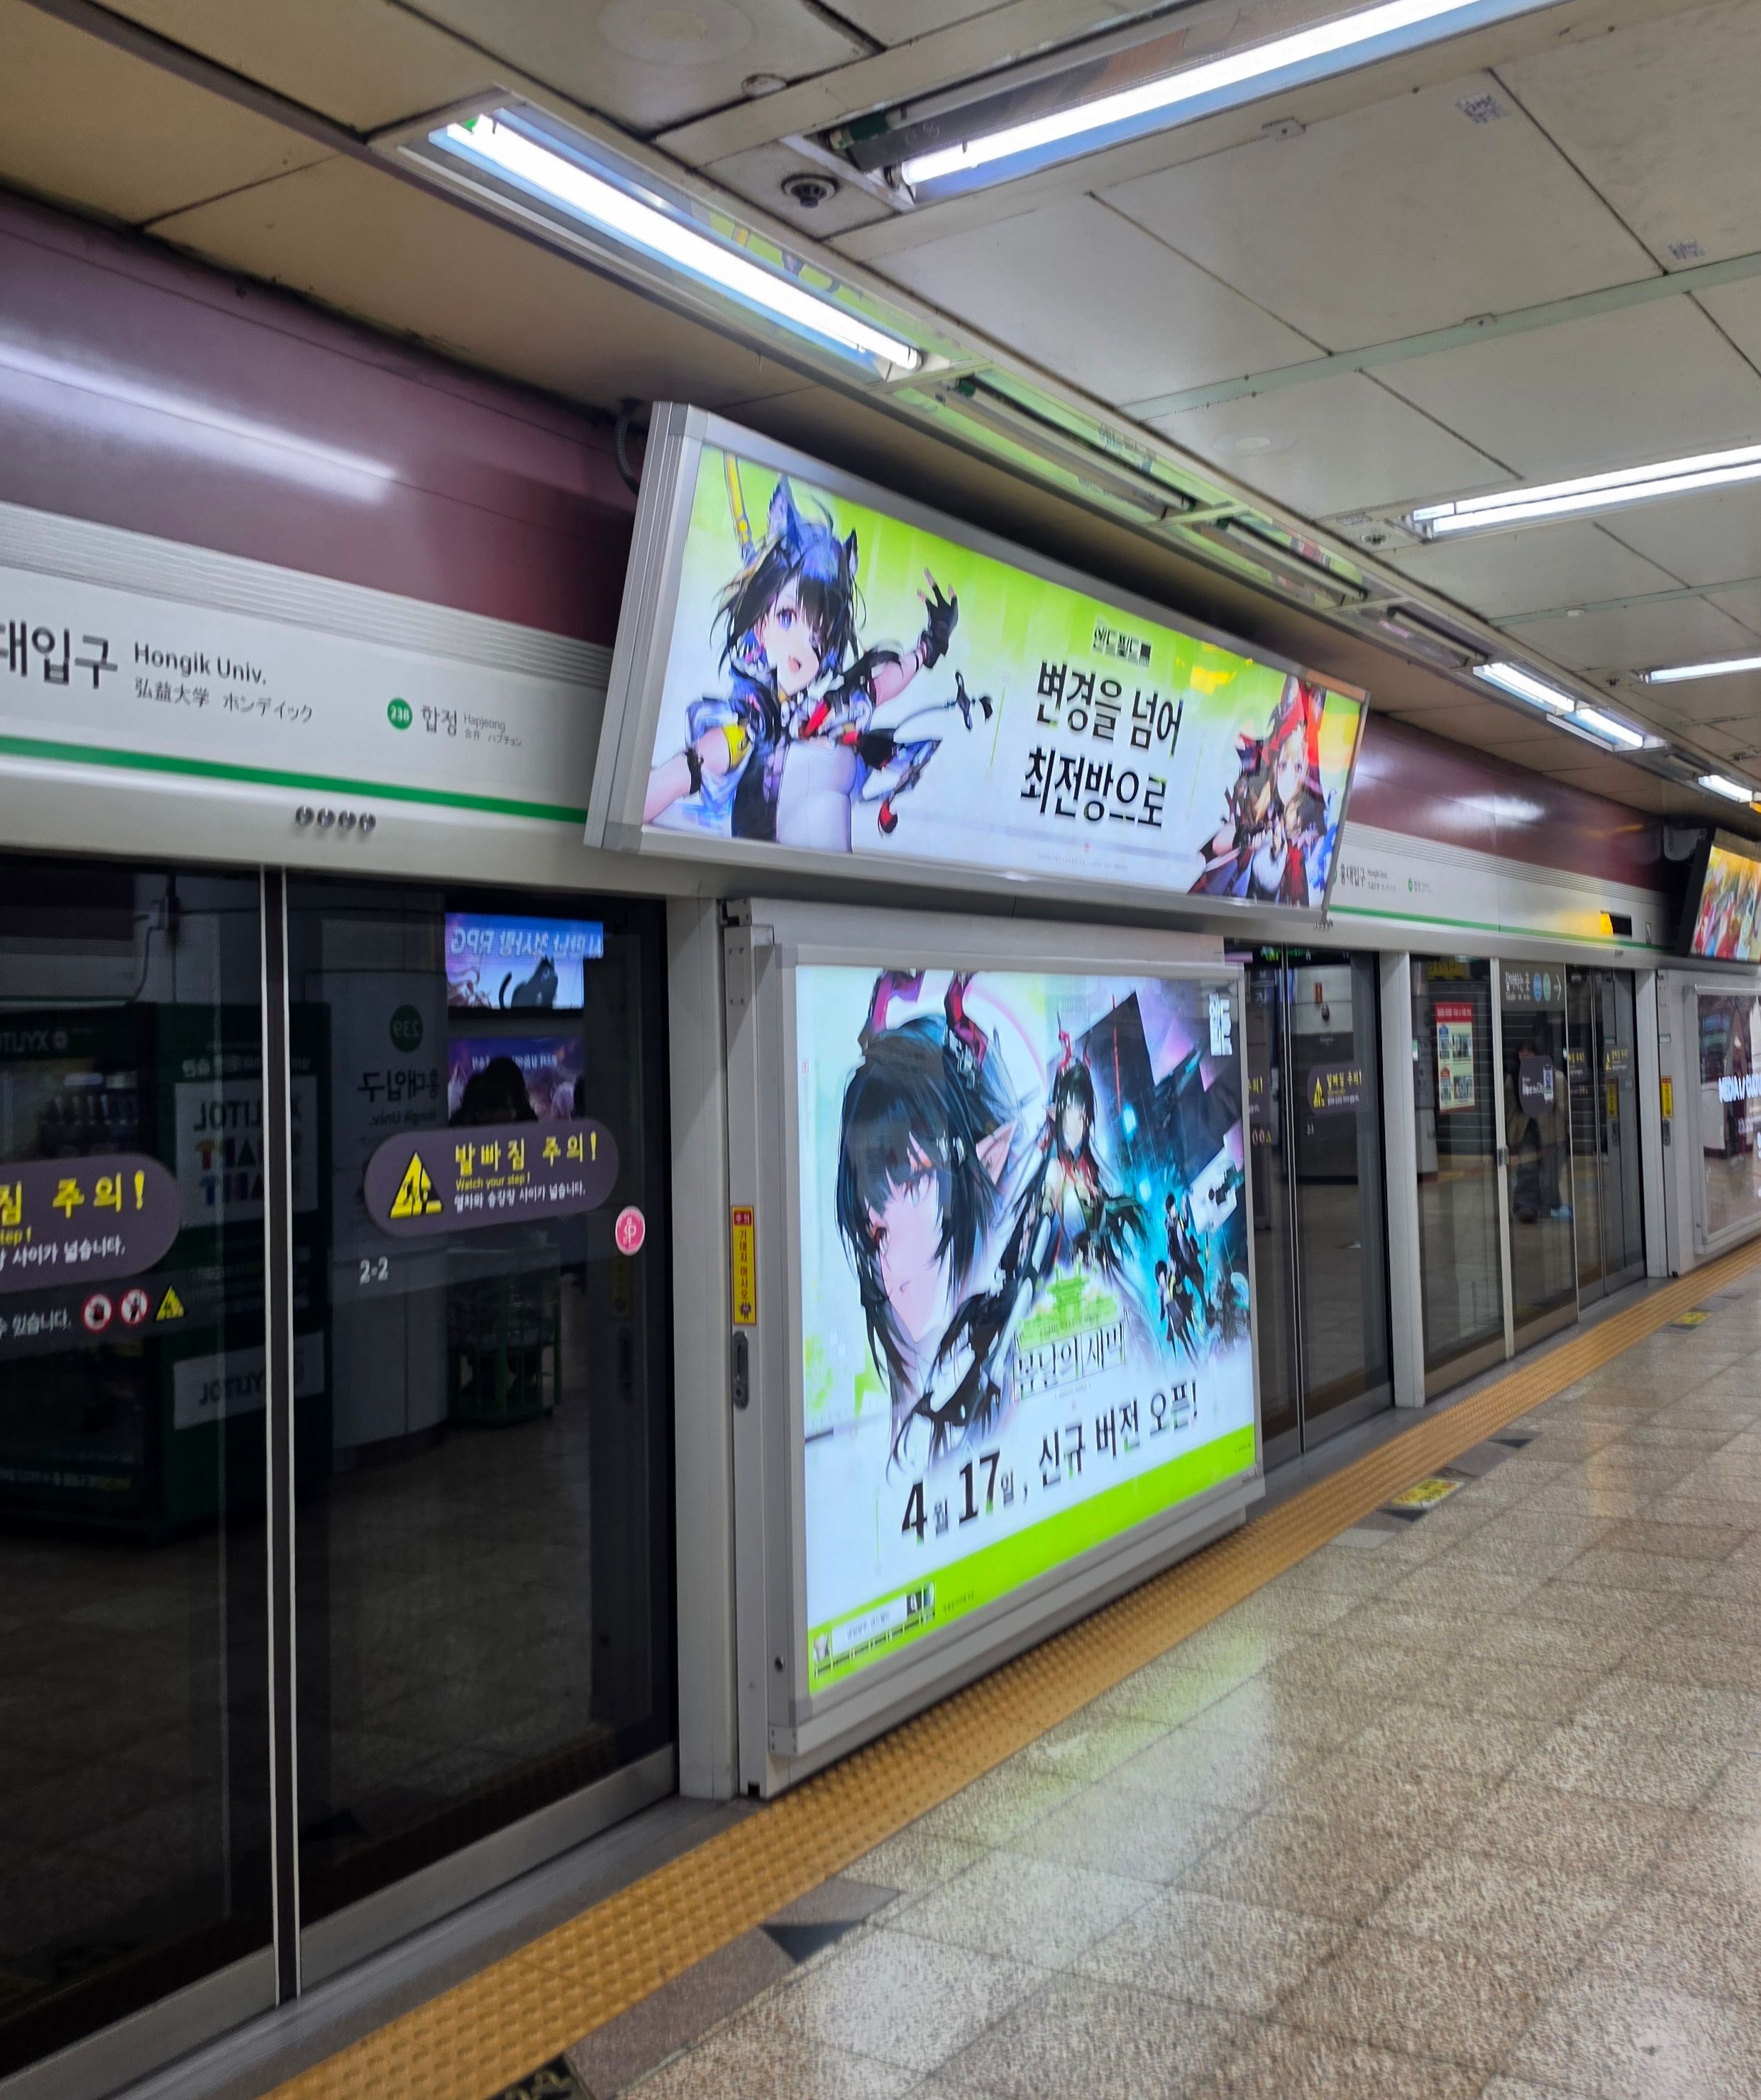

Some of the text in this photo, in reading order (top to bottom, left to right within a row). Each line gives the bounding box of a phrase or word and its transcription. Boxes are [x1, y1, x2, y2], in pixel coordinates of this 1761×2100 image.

[135, 641, 211, 678] Hongik
[135, 677, 210, 708] 弘益大学
[421, 704, 457, 737] 합정
[463, 712, 506, 733] Hapjeong
[1037, 660, 1184, 760] 변경을 넘어
[1020, 745, 1168, 828] 최전방으로
[455, 1130, 597, 1177] 발빠짐 주의!
[52, 1169, 145, 1219] 주의!
[456, 1176, 484, 1193] Watch
[486, 1176, 505, 1190] your
[519, 1183, 546, 1205] 사이가
[12, 1241, 59, 1269] 사이가
[359, 1255, 389, 1285] 2-2
[901, 1480, 949, 1545] 4월
[1039, 1422, 1086, 1488] 신규
[1095, 1396, 1141, 1461] 버전
[1149, 1378, 1198, 1438] 오픈!
